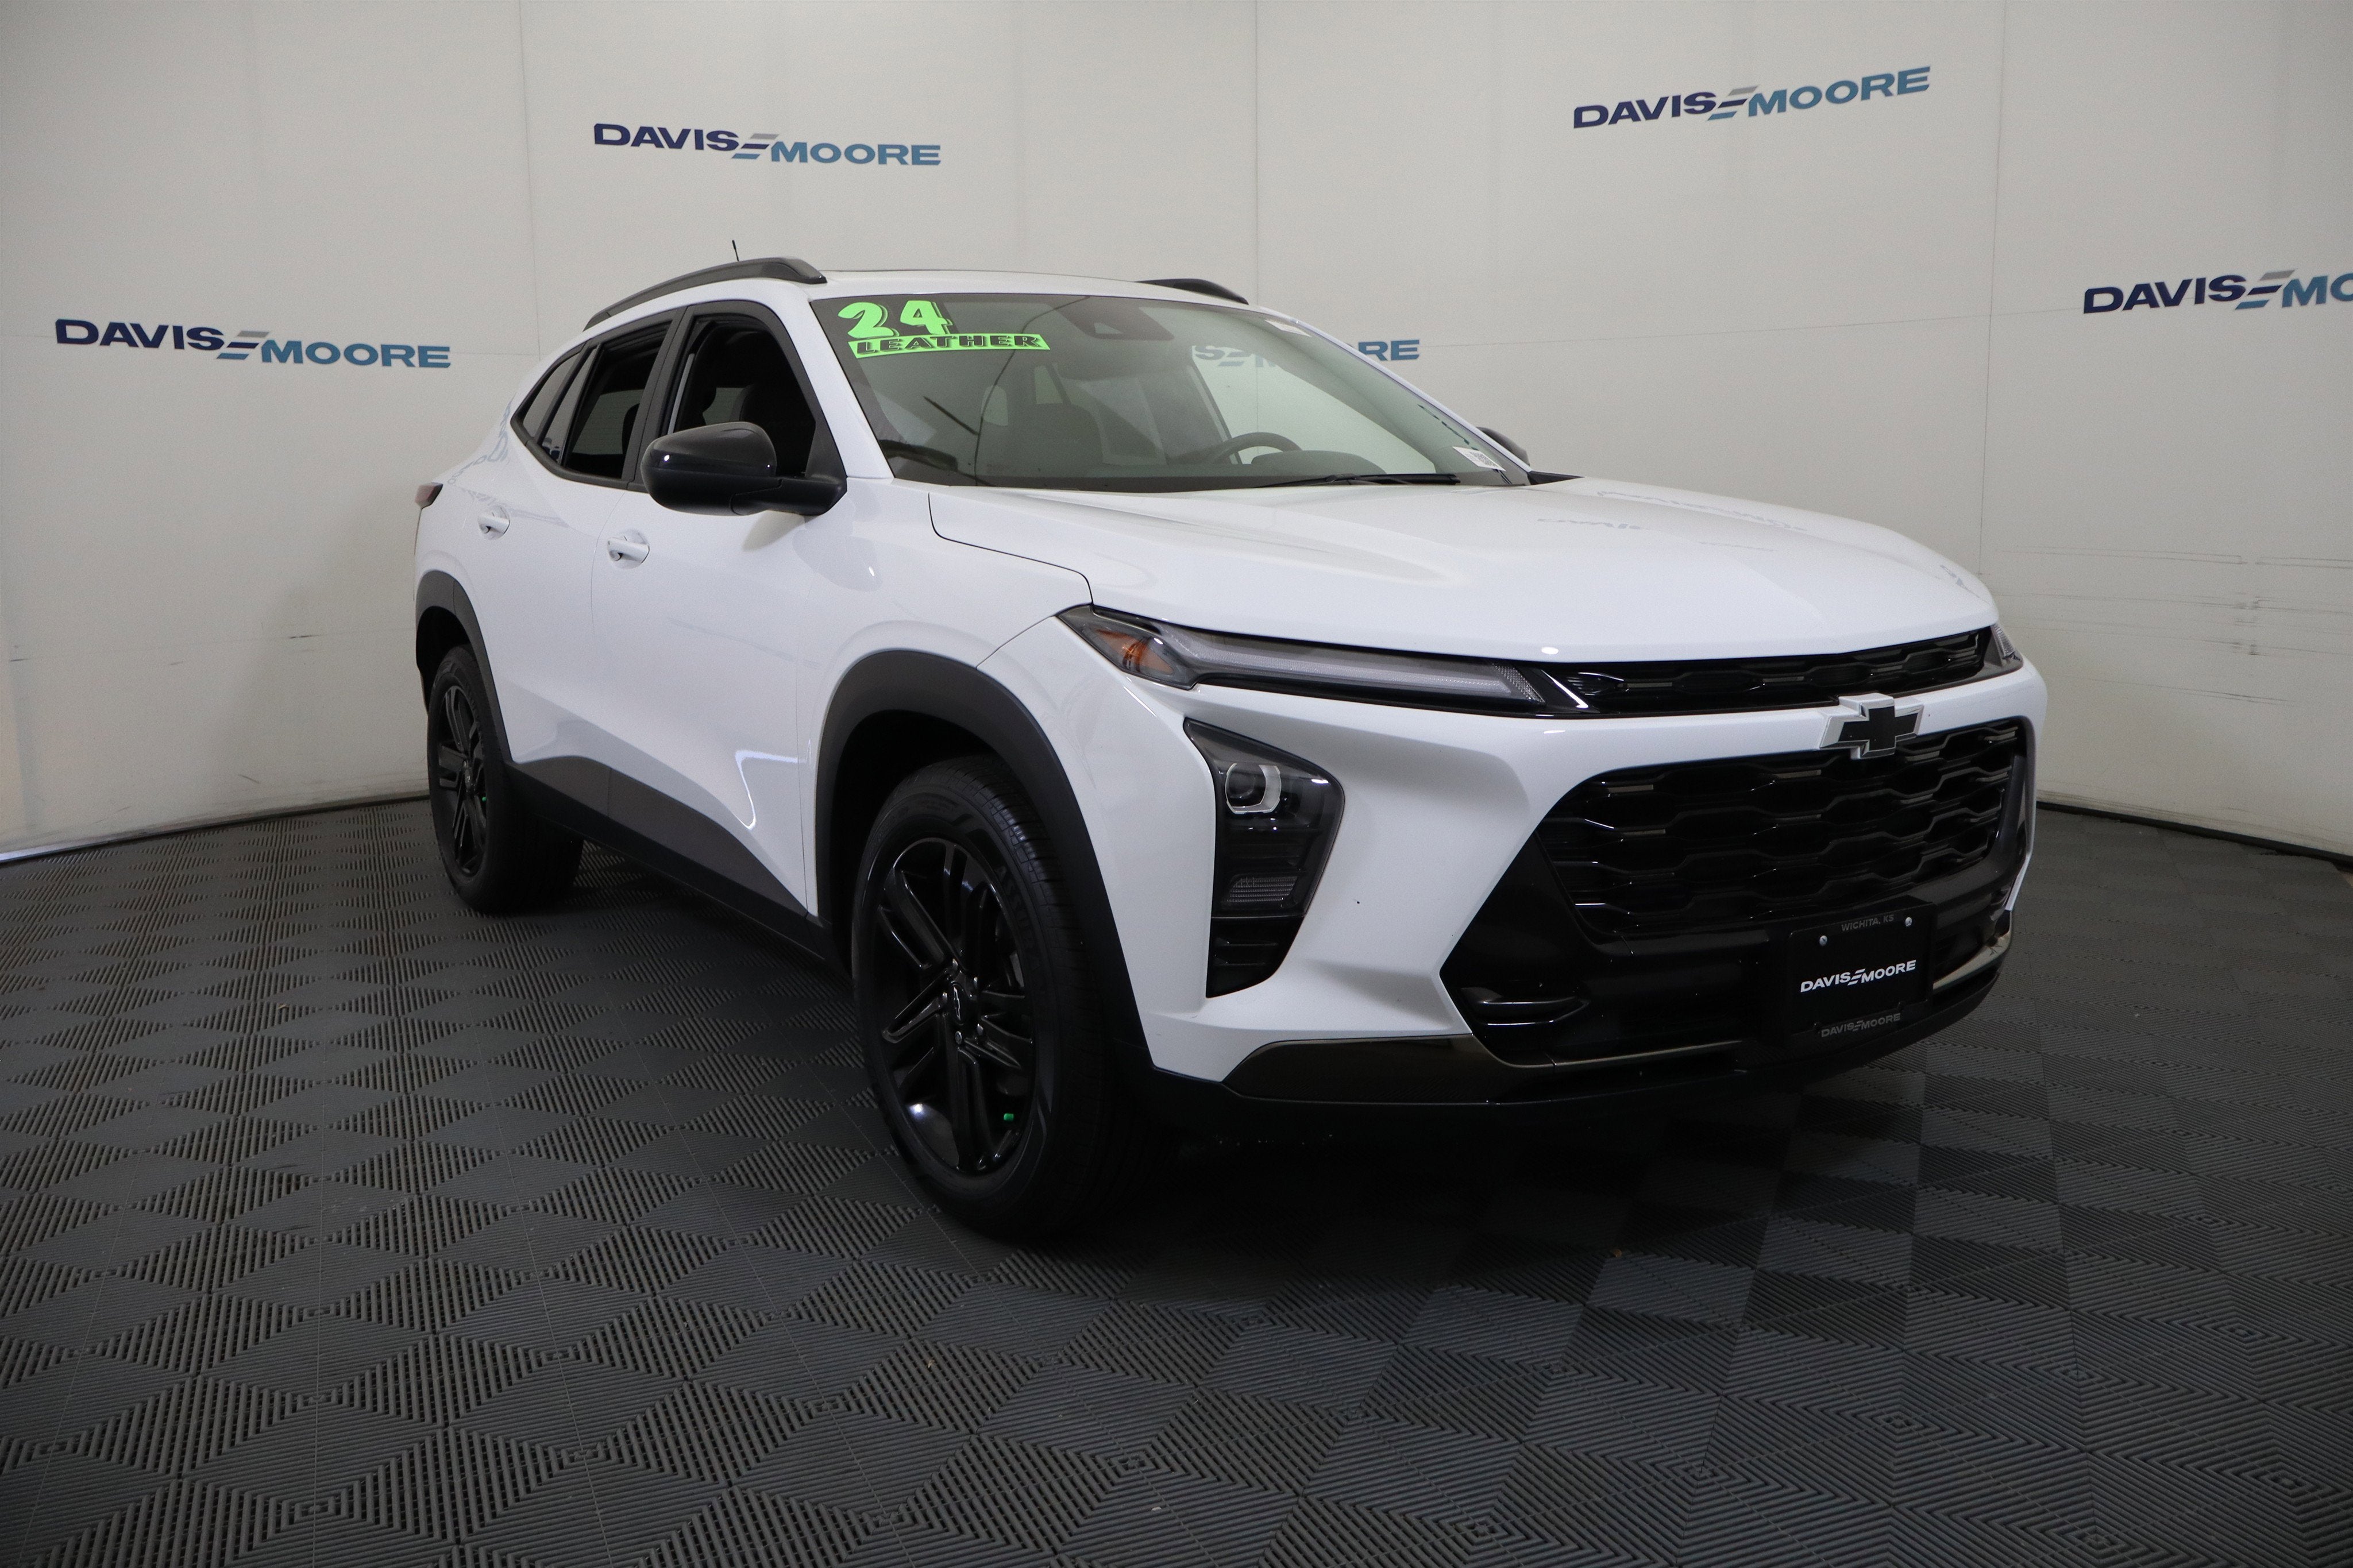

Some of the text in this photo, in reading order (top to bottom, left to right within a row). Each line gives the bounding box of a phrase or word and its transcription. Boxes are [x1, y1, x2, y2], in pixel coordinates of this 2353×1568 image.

[1573, 66, 1931, 129] DAVIS MOORE
[593, 123, 942, 166] DAVIS MOORE
[2084, 275, 2247, 314] DAVIS
[838, 300, 953, 339] 24
[55, 319, 451, 368] DAVIS MOORE
[857, 334, 1041, 355] LEATHER
[1883, 914, 1895, 924] KS
[1800, 960, 1917, 993] DAVIS MOORE
[1821, 1013, 1901, 1038] DAVIS MOORE
